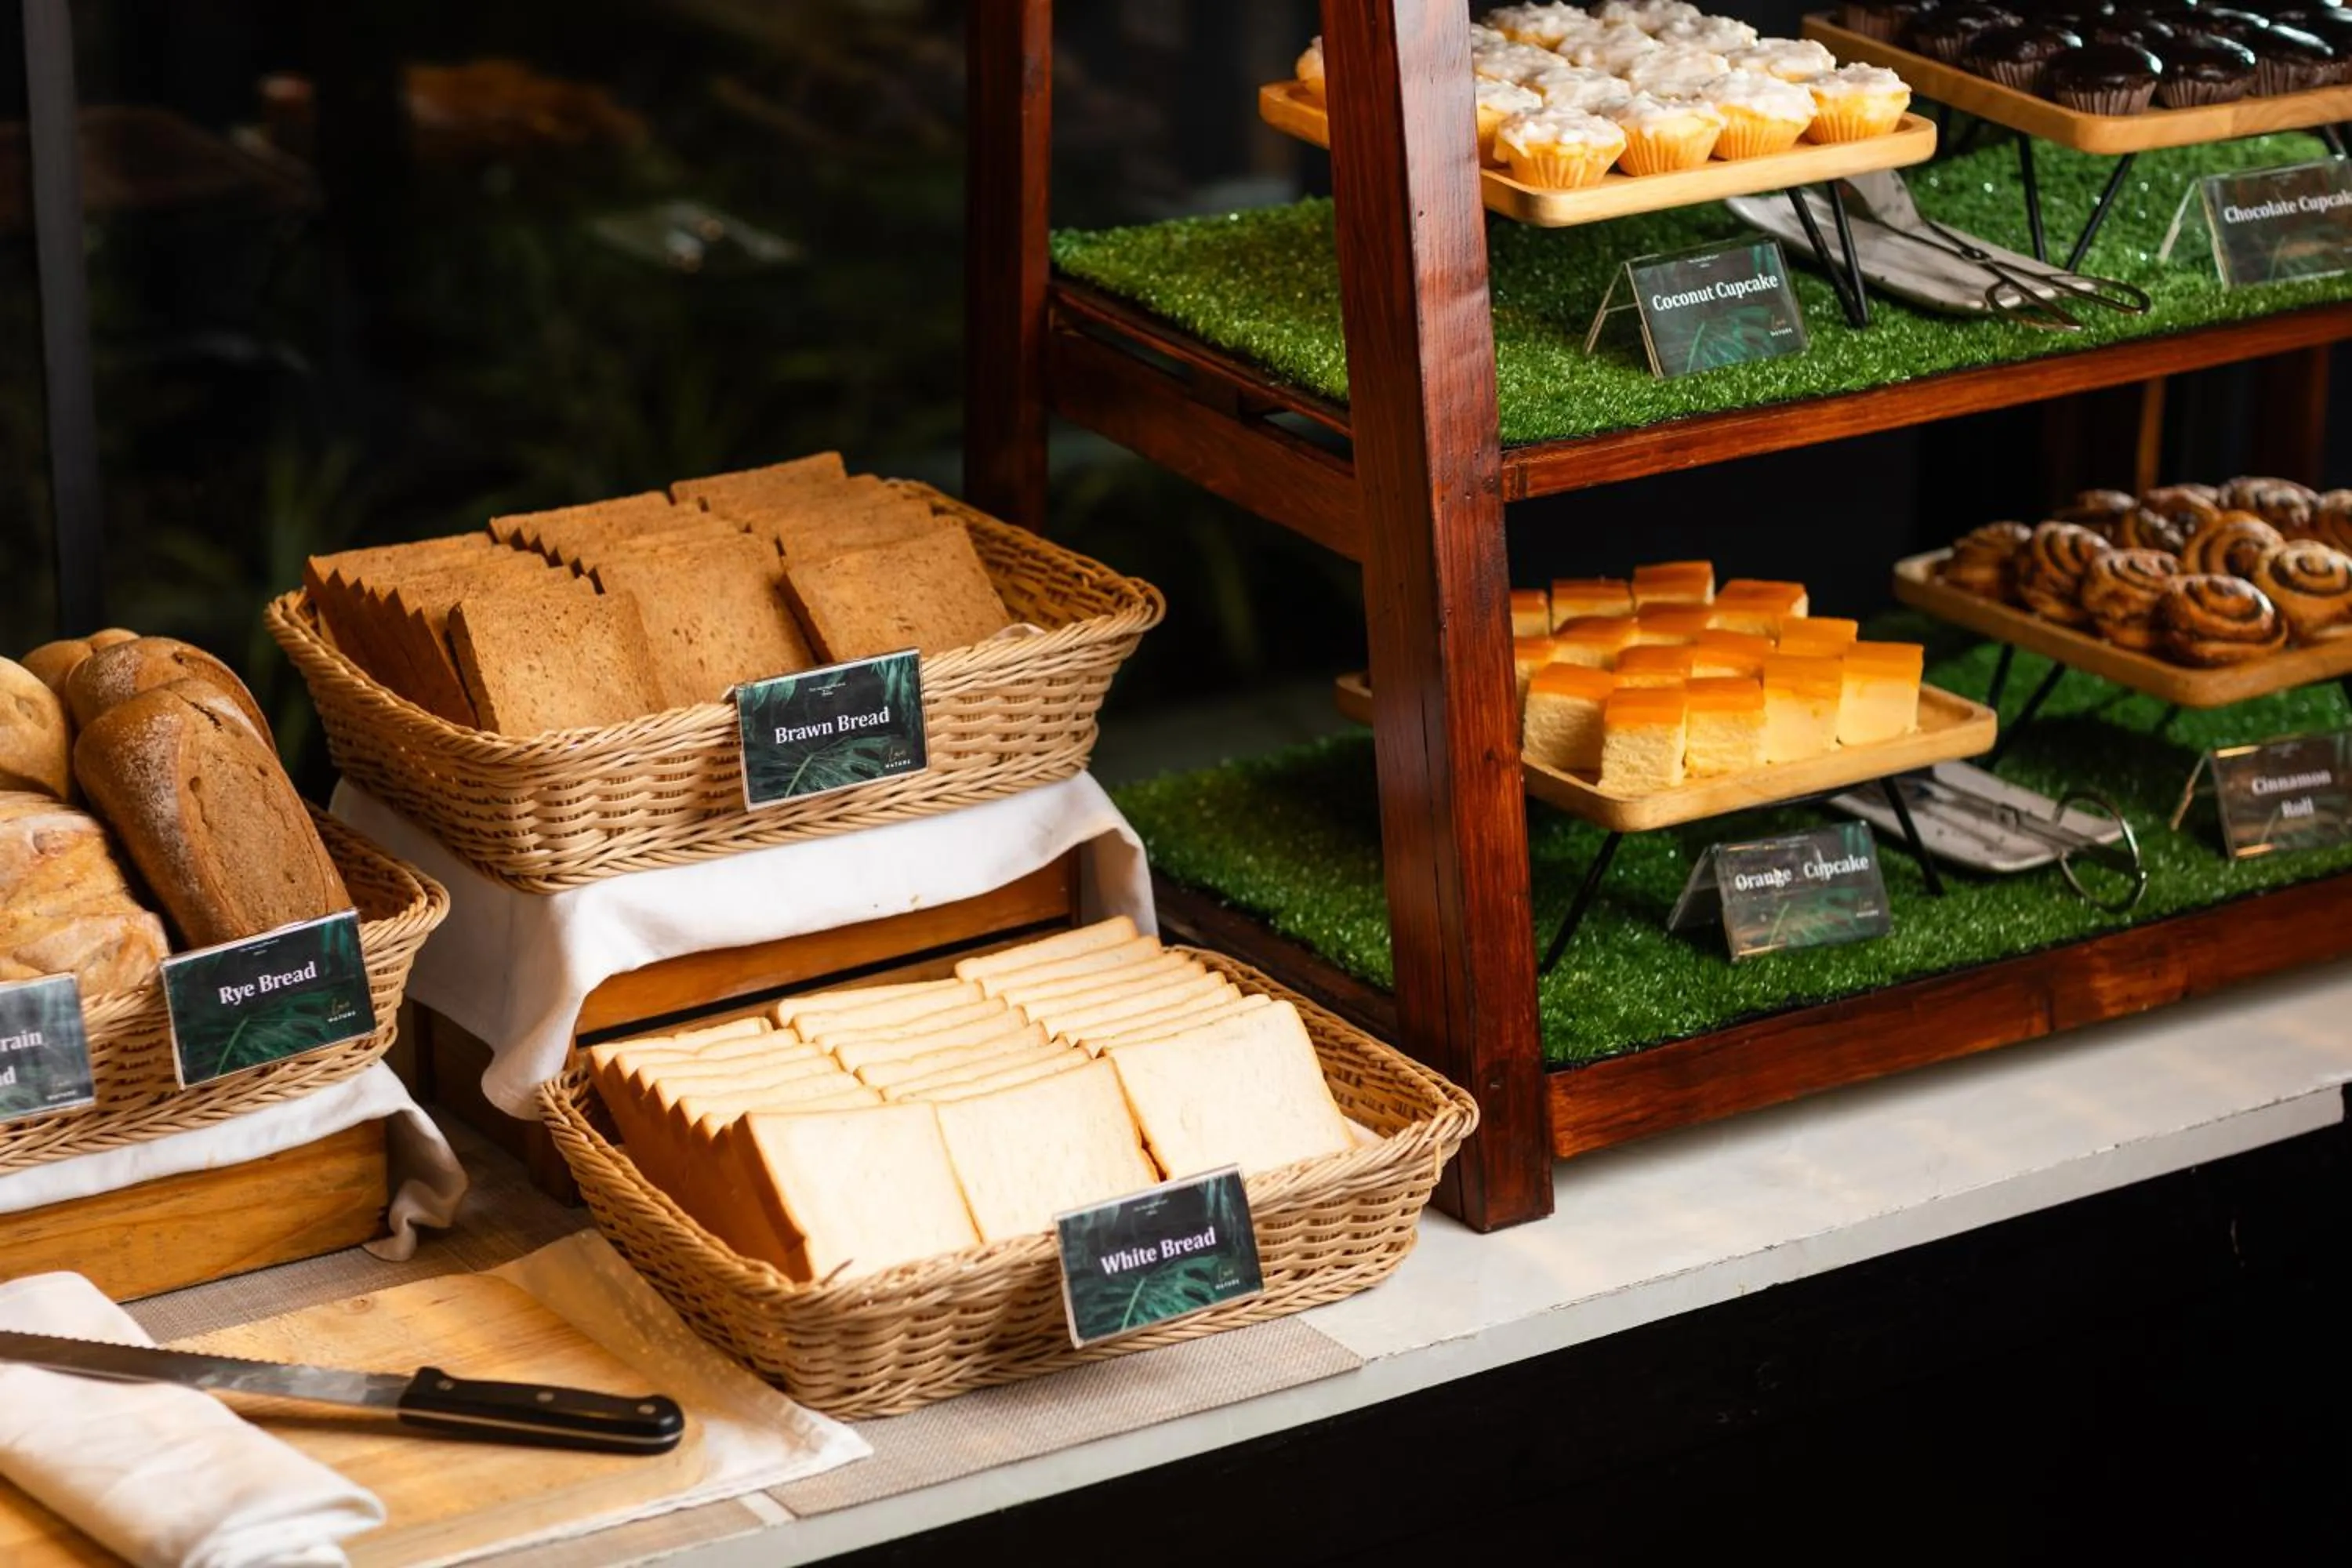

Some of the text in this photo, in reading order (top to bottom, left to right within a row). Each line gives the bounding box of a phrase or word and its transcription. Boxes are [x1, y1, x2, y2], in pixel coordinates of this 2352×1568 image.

[2223, 200, 2298, 223] Chocolate
[1652, 273, 1779, 311] Coconut Cupcake
[775, 706, 890, 745] Brawn Bread
[2252, 769, 2332, 796] Cinnamon
[2281, 795, 2314, 818] Roll
[1735, 854, 1869, 891] Orange Cupcake
[218, 960, 318, 1006] Rye Bread
[1100, 1225, 1217, 1275] White Bread
